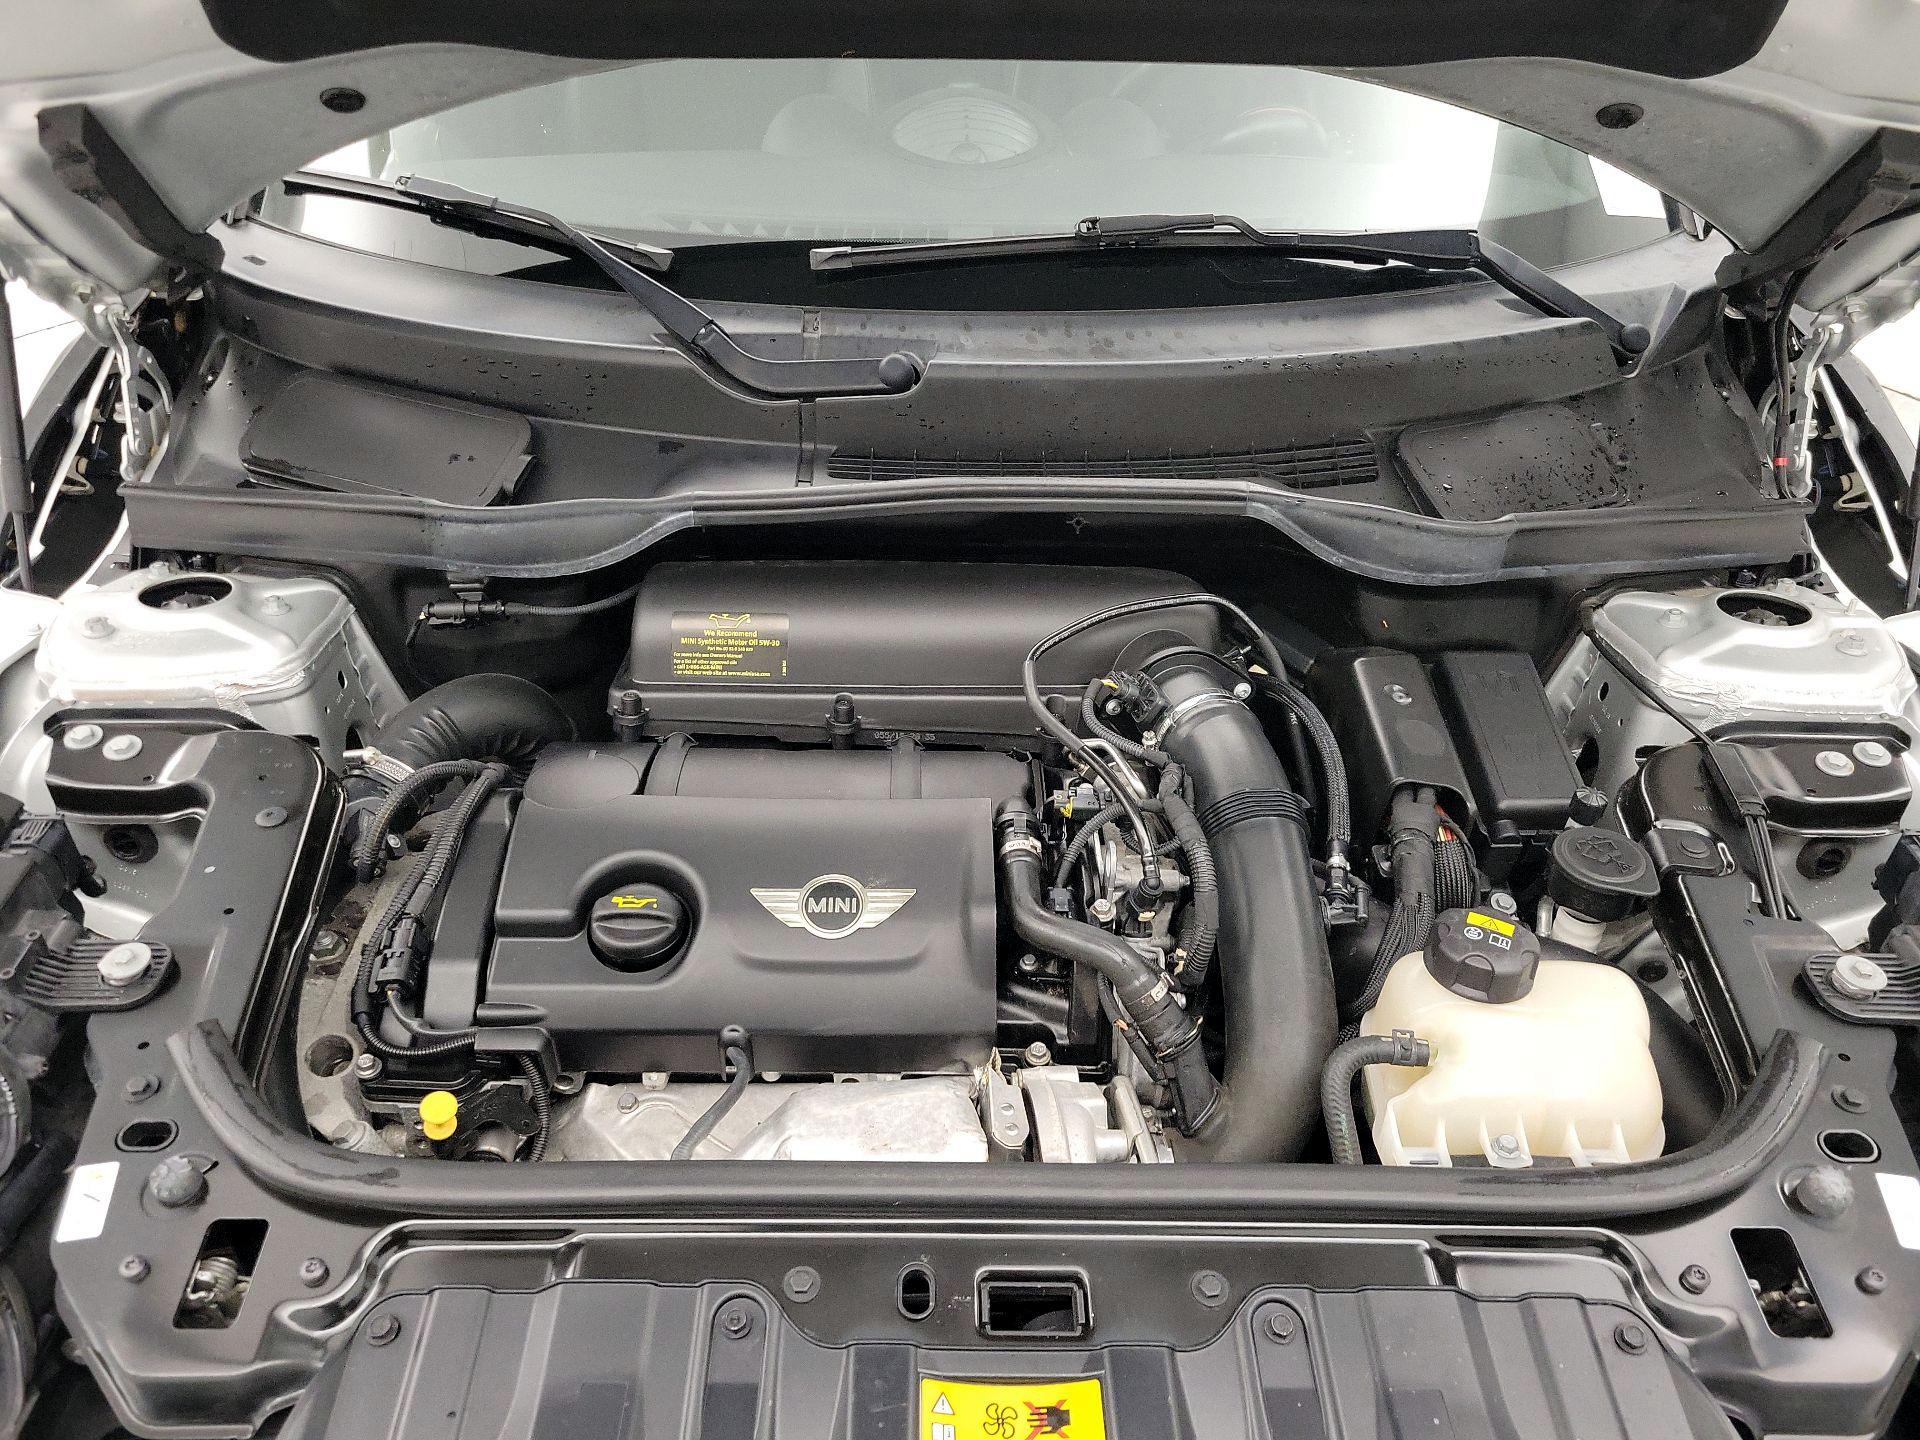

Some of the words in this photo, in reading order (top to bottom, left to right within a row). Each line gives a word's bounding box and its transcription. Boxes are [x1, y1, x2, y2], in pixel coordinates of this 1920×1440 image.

[704, 629, 715, 637] We
[716, 629, 758, 638] Recommend
[681, 637, 697, 645] MINI
[698, 637, 728, 646] Synthetic
[728, 638, 748, 646] Motor
[749, 638, 758, 646] Oil
[759, 639, 780, 647] 5W-30
[807, 897, 857, 914] MINI
